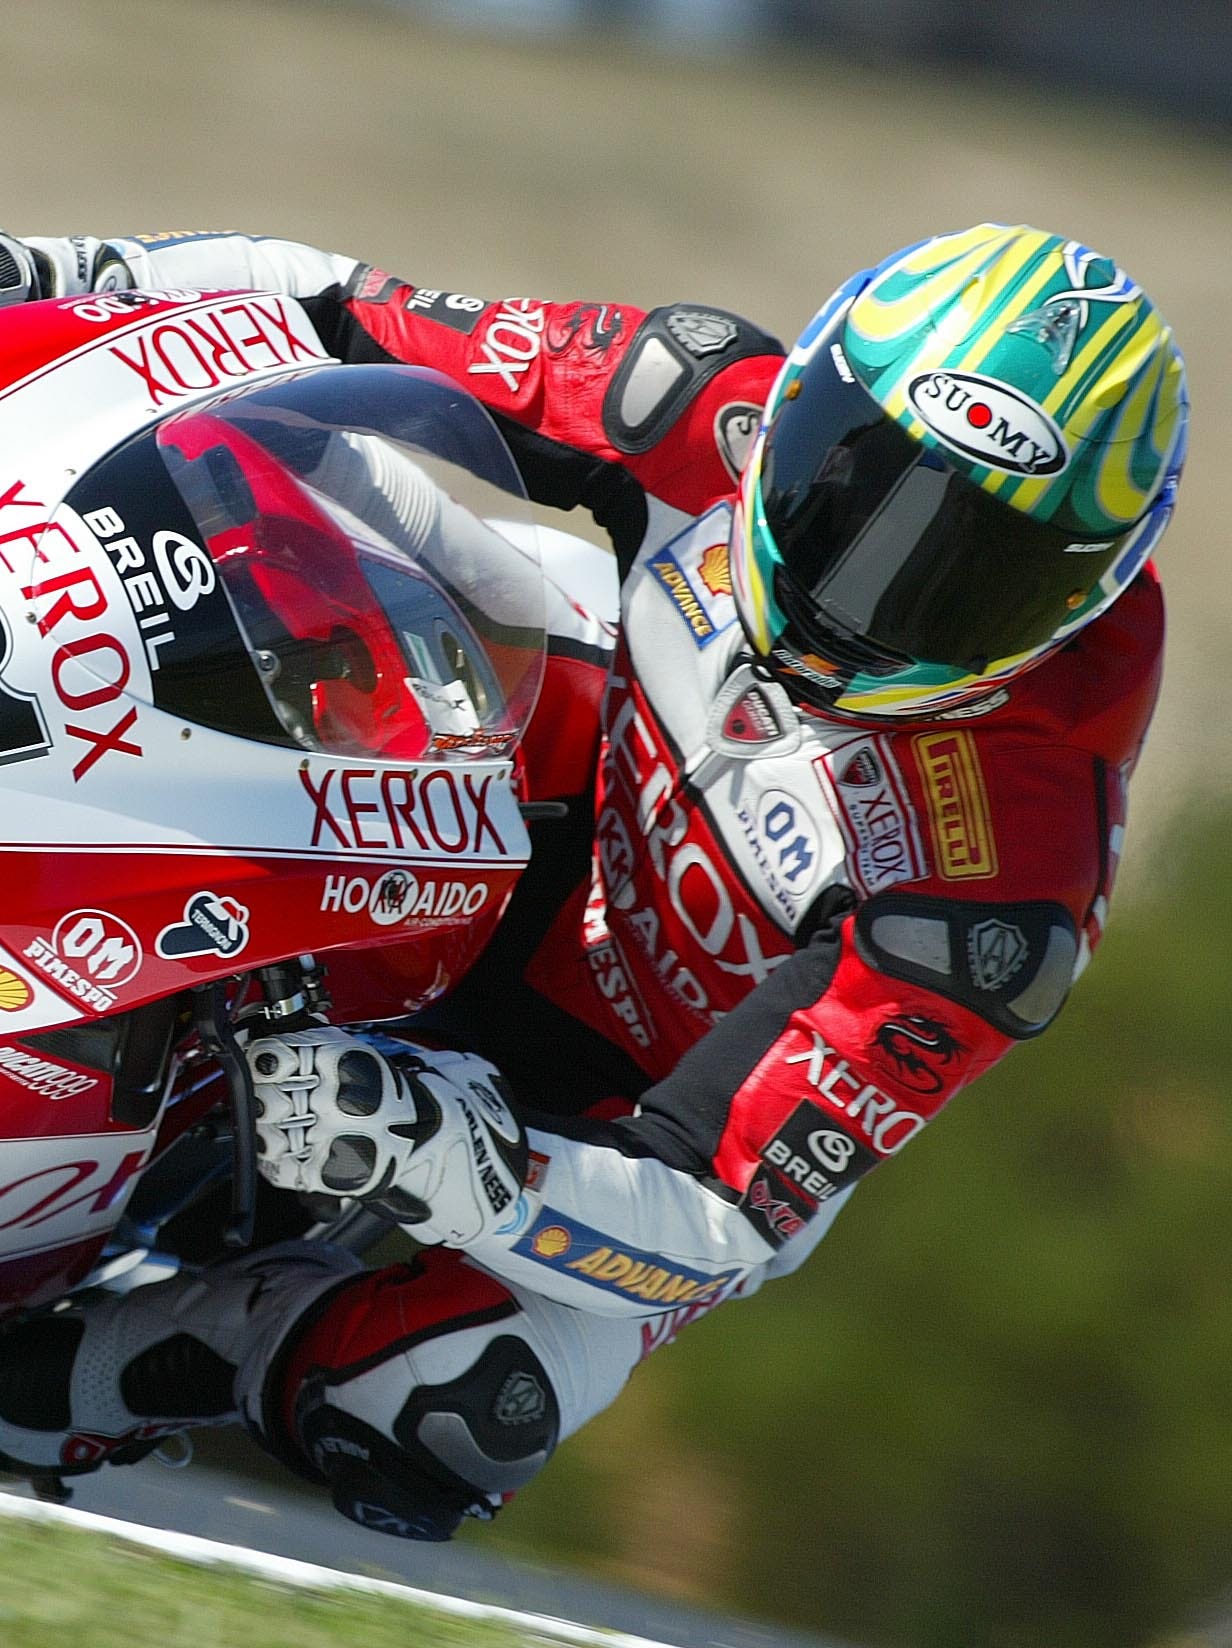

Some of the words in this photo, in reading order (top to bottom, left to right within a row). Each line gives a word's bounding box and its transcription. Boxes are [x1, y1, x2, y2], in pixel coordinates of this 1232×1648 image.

[107, 297, 332, 406] XEROX
[82, 506, 177, 671] BREIL
[652, 562, 713, 637] ADVANCE
[298, 768, 509, 856] XEROX
[764, 800, 814, 882] OM
[858, 789, 908, 880] XEROX
[926, 737, 981, 867] PIRELLI
[22, 936, 117, 1012] PIMESPO
[61, 917, 135, 979] OM
[784, 1030, 926, 1155] XERO
[477, 1162, 514, 1216] NESS
[763, 1139, 838, 1200] BREIL
